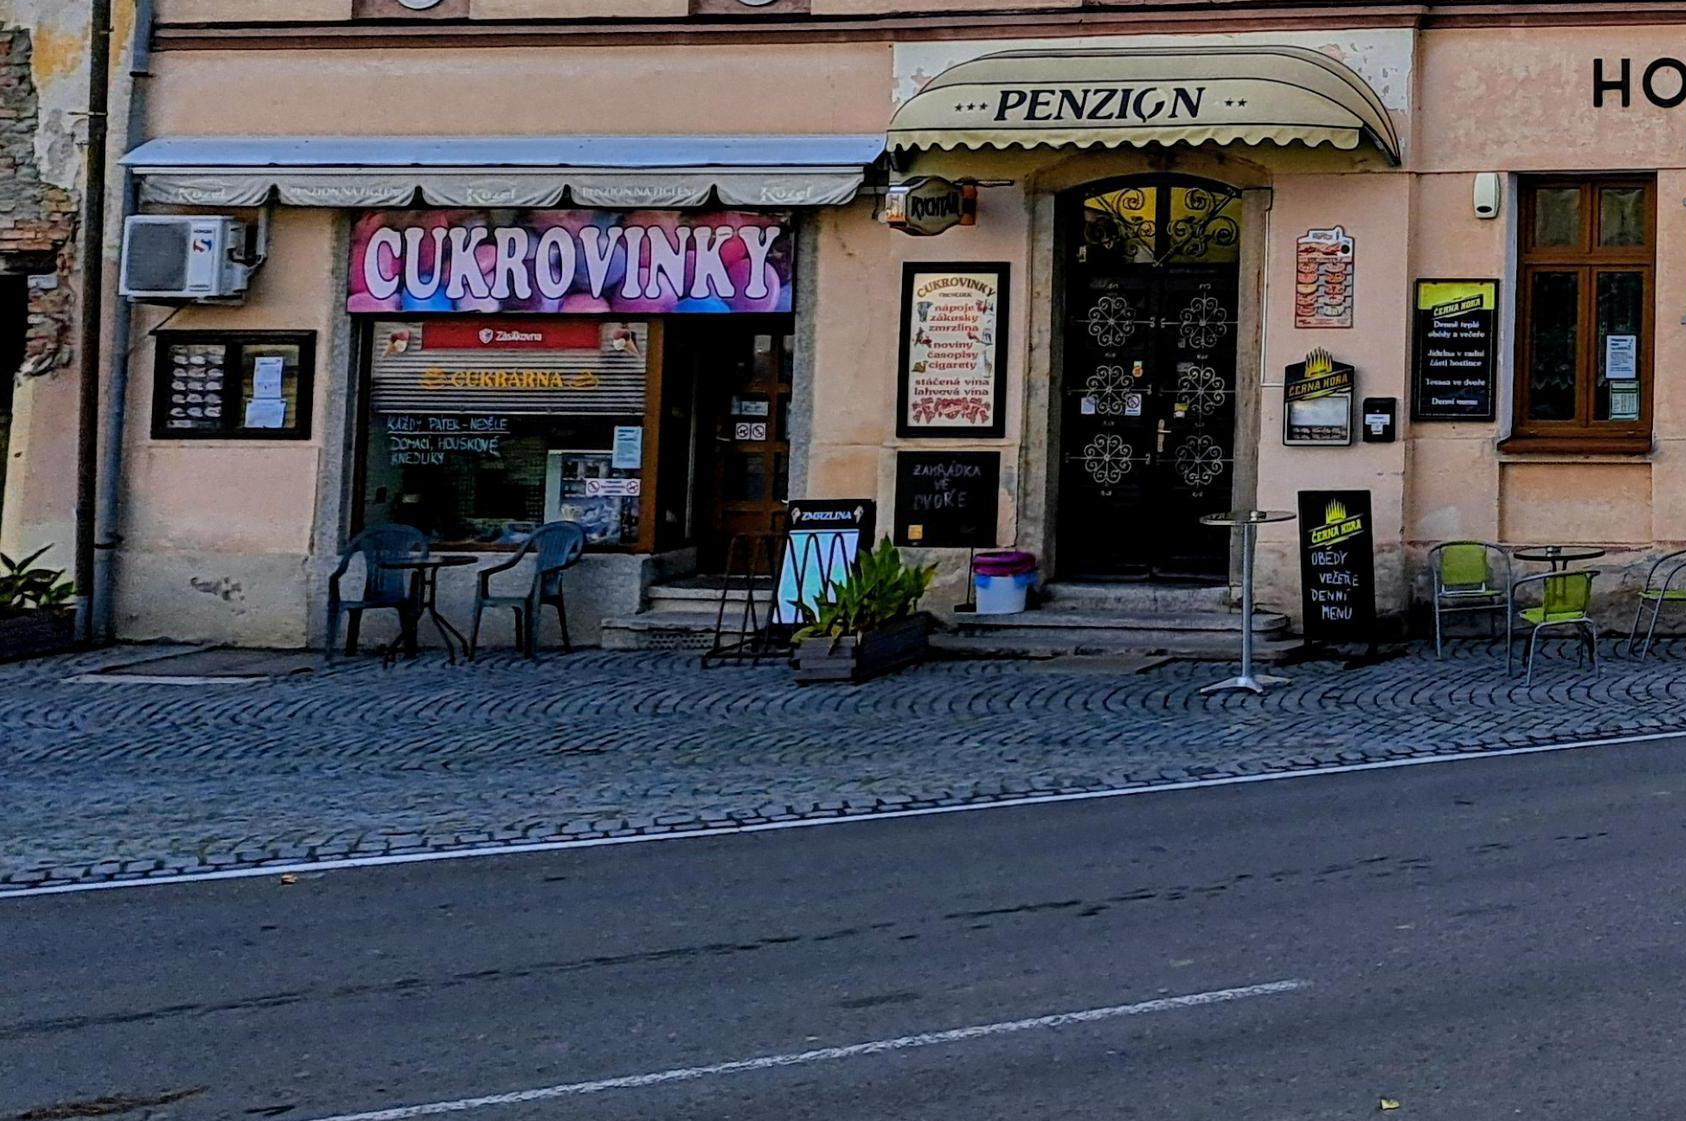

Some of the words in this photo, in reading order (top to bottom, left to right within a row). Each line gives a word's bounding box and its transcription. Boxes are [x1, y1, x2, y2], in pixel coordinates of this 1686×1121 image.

[994, 86, 1206, 122] PENZION
[363, 225, 781, 300] CUKROVINKY
[916, 276, 997, 298] CUKROVINKY
[934, 303, 975, 313] nápoje
[930, 313, 980, 323] zákusky
[929, 323, 980, 332] zmrzlina
[933, 340, 974, 350] noviny
[927, 349, 980, 360] časopisy
[928, 360, 978, 370] cigarety
[450, 368, 564, 389] CUKRÁRNA
[915, 377, 961, 386] stáčená
[1322, 373, 1349, 390] HORA
[914, 387, 960, 396] lahvová
[801, 510, 853, 521] ZMRZLINA
[1321, 605, 1353, 620] MENU
